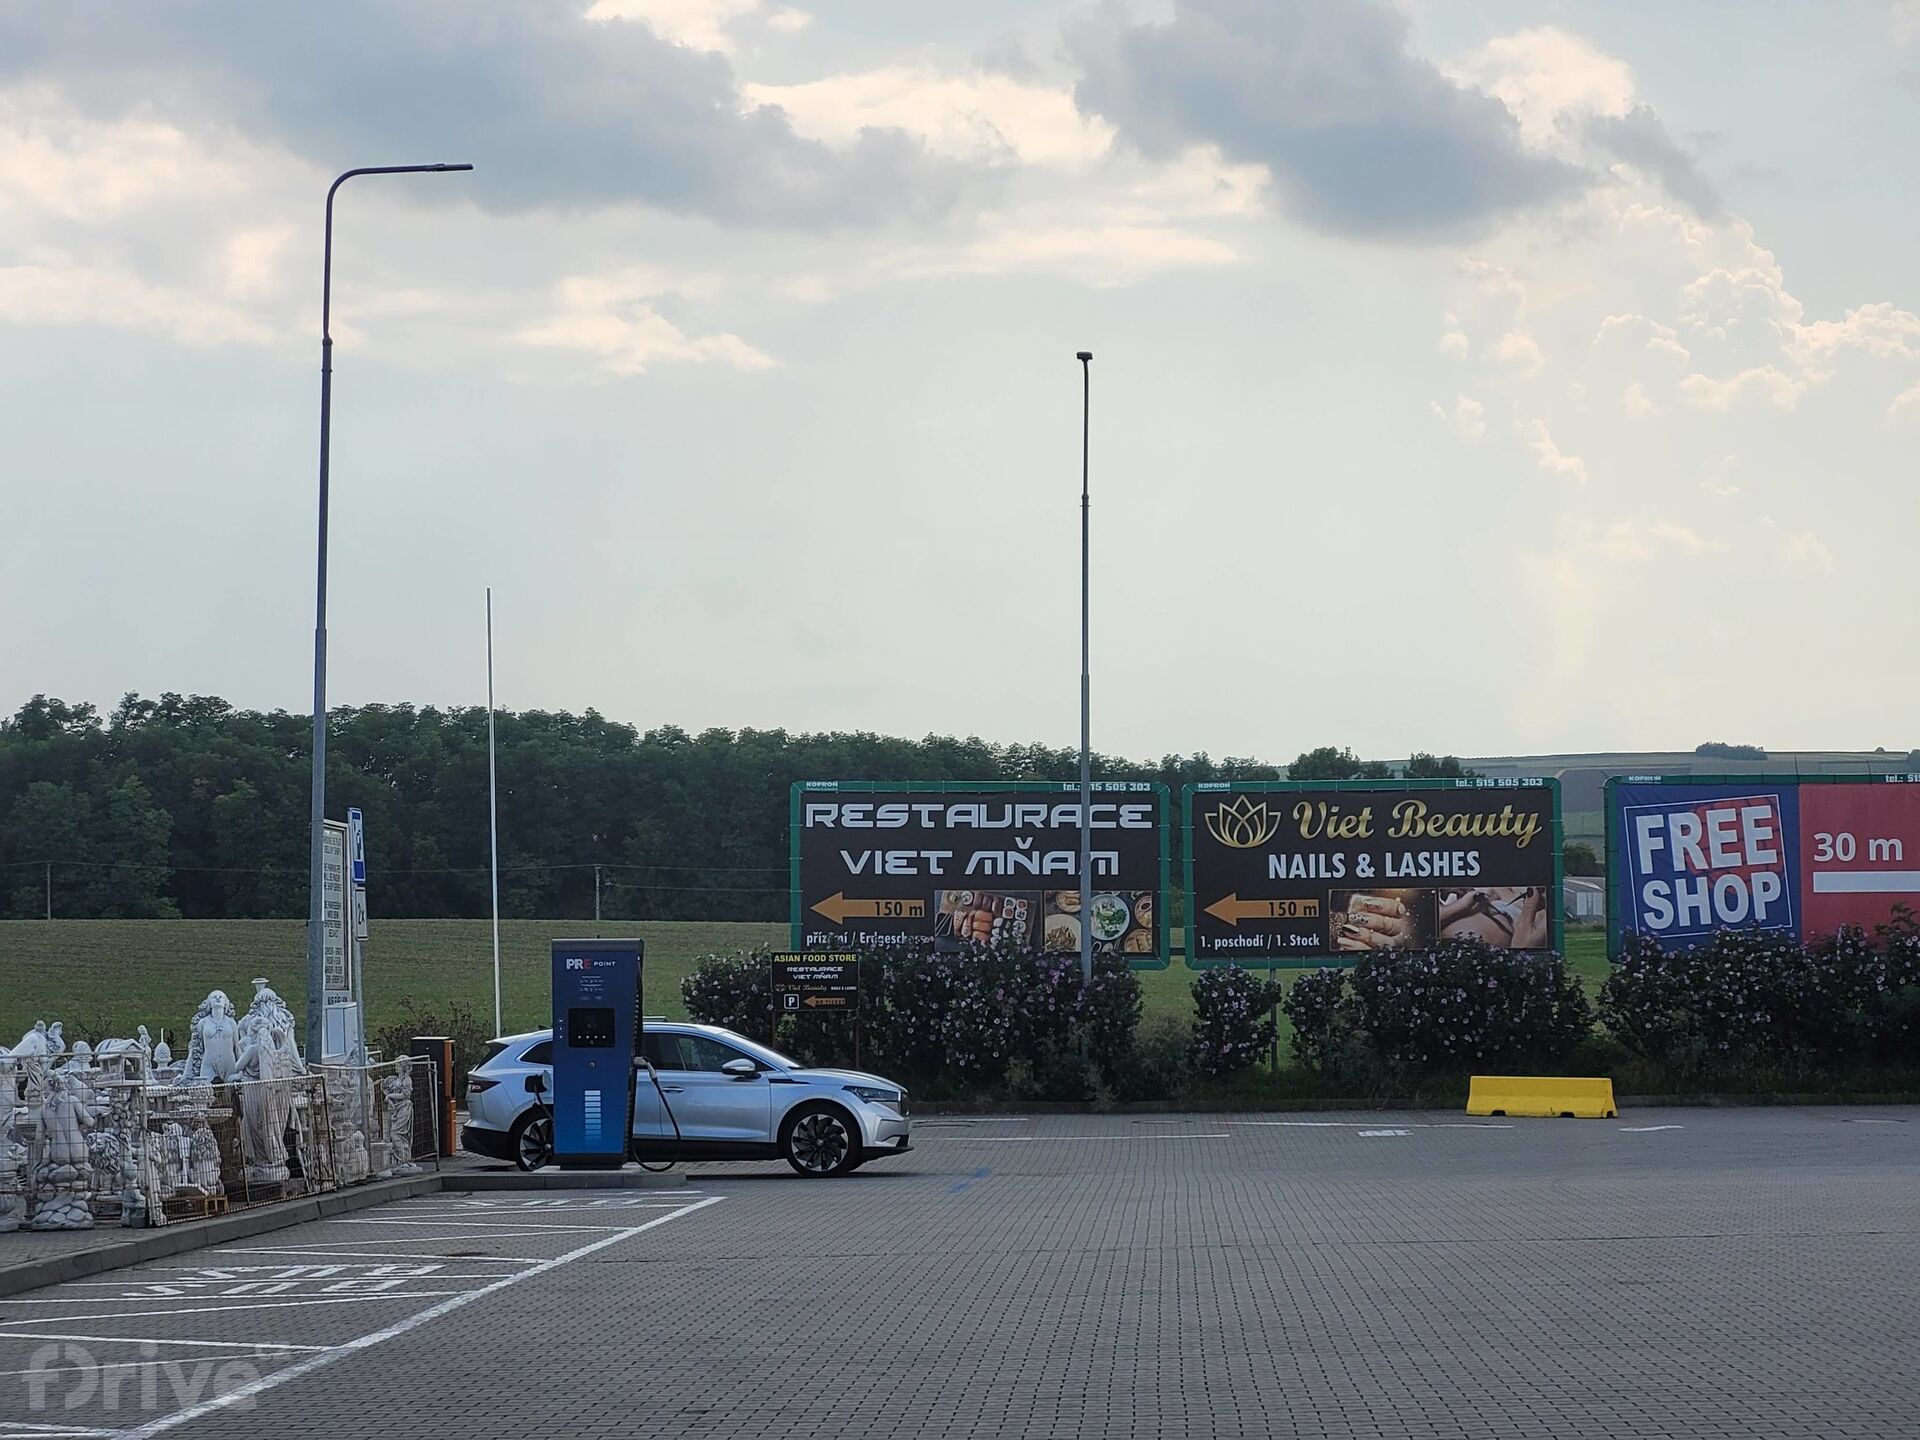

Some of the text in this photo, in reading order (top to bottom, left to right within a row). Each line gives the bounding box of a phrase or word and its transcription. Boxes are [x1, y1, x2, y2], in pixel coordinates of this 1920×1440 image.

[1105, 783, 1127, 791] 505
[1129, 782, 1151, 791] 303
[1476, 778, 1495, 787] 515
[1497, 778, 1519, 787] 505
[1521, 778, 1543, 787] 303
[805, 803, 1153, 829] RESTAURACE
[1292, 799, 1543, 849] Viet Beauty
[1635, 804, 1778, 875] FREE
[1812, 832, 1903, 862] 30 m
[840, 836, 1119, 876] VIET MŇAM
[1268, 850, 1481, 880] NAILS & LASHES
[874, 901, 924, 917] 150 m
[1268, 901, 1318, 917] 150 m
[1642, 871, 1782, 930] SHOP
[1200, 936, 1211, 948] 1.
[1214, 934, 1264, 950] poschodí
[1276, 935, 1287, 947] 1.
[1289, 934, 1320, 948] Stock
[803, 954, 827, 962] FOOD
[828, 954, 857, 962] STORE
